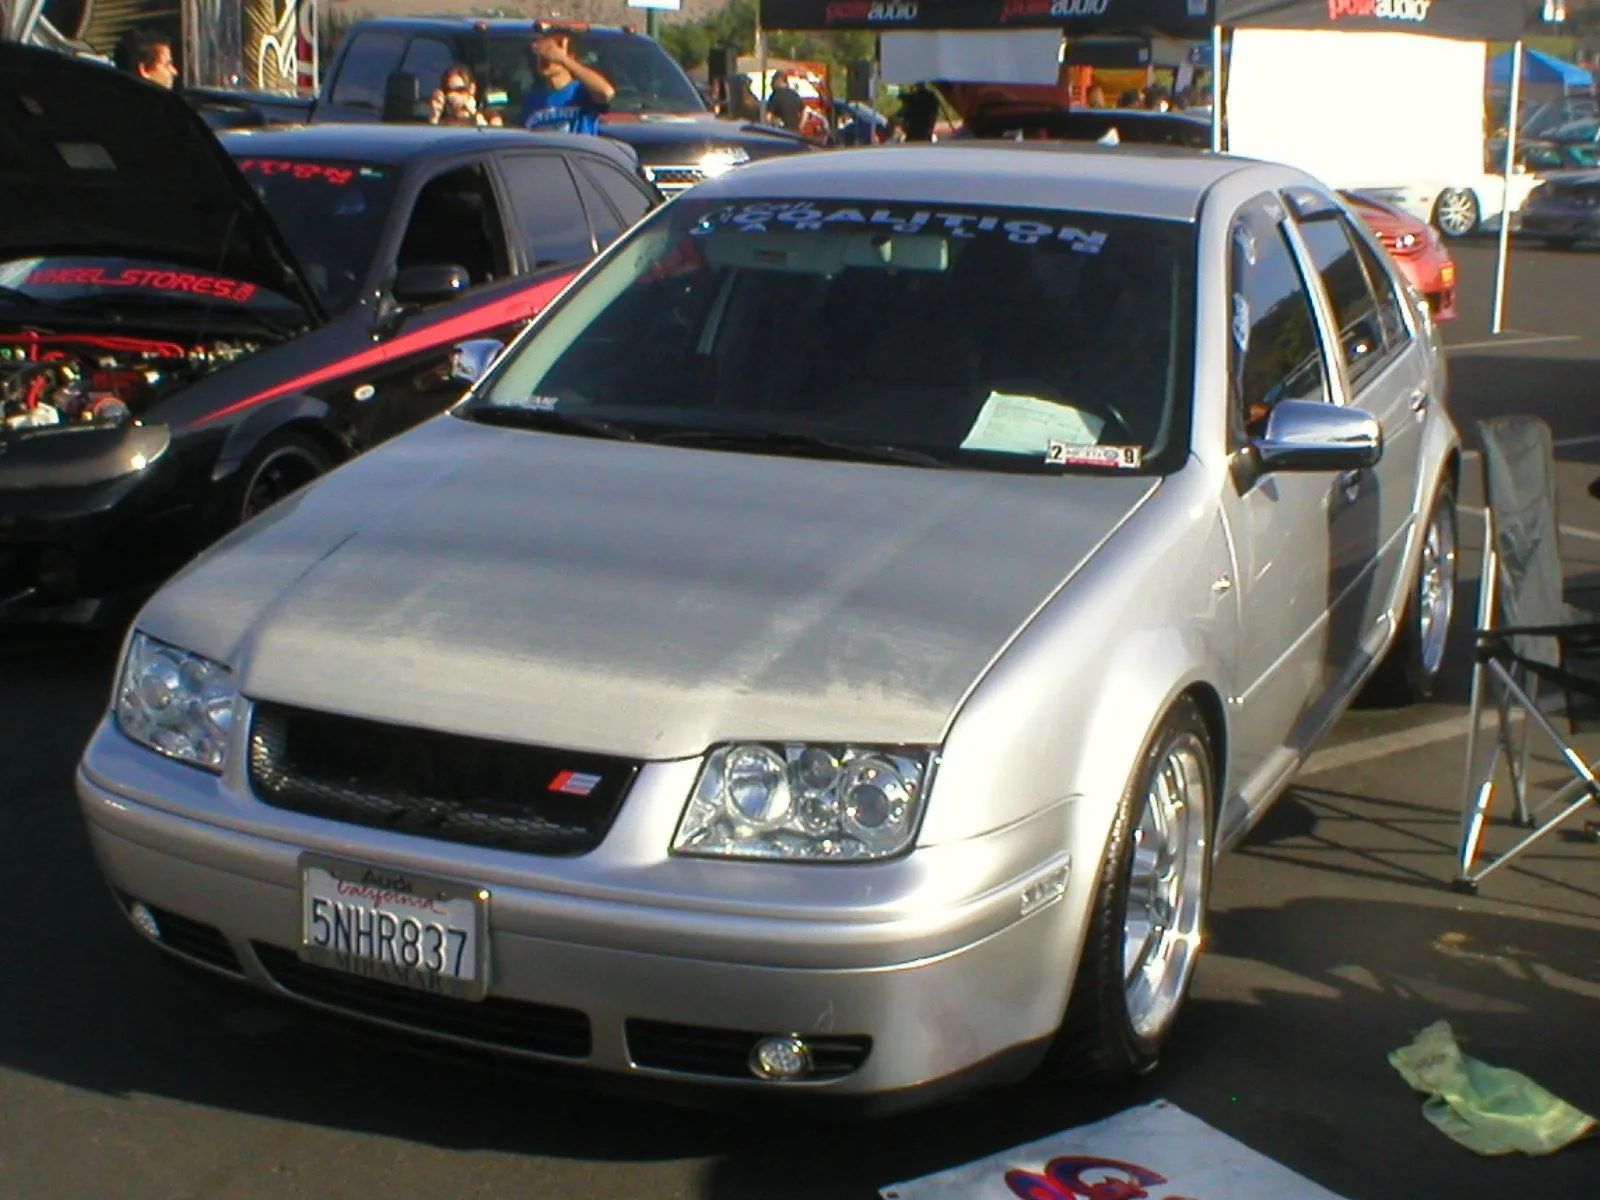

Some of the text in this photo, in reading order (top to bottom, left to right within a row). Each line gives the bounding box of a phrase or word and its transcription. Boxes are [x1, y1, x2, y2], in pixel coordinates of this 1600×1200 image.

[733, 207, 1108, 246] COALITION
[362, 869, 414, 893] Audi
[312, 896, 468, 978] 5NHR837
